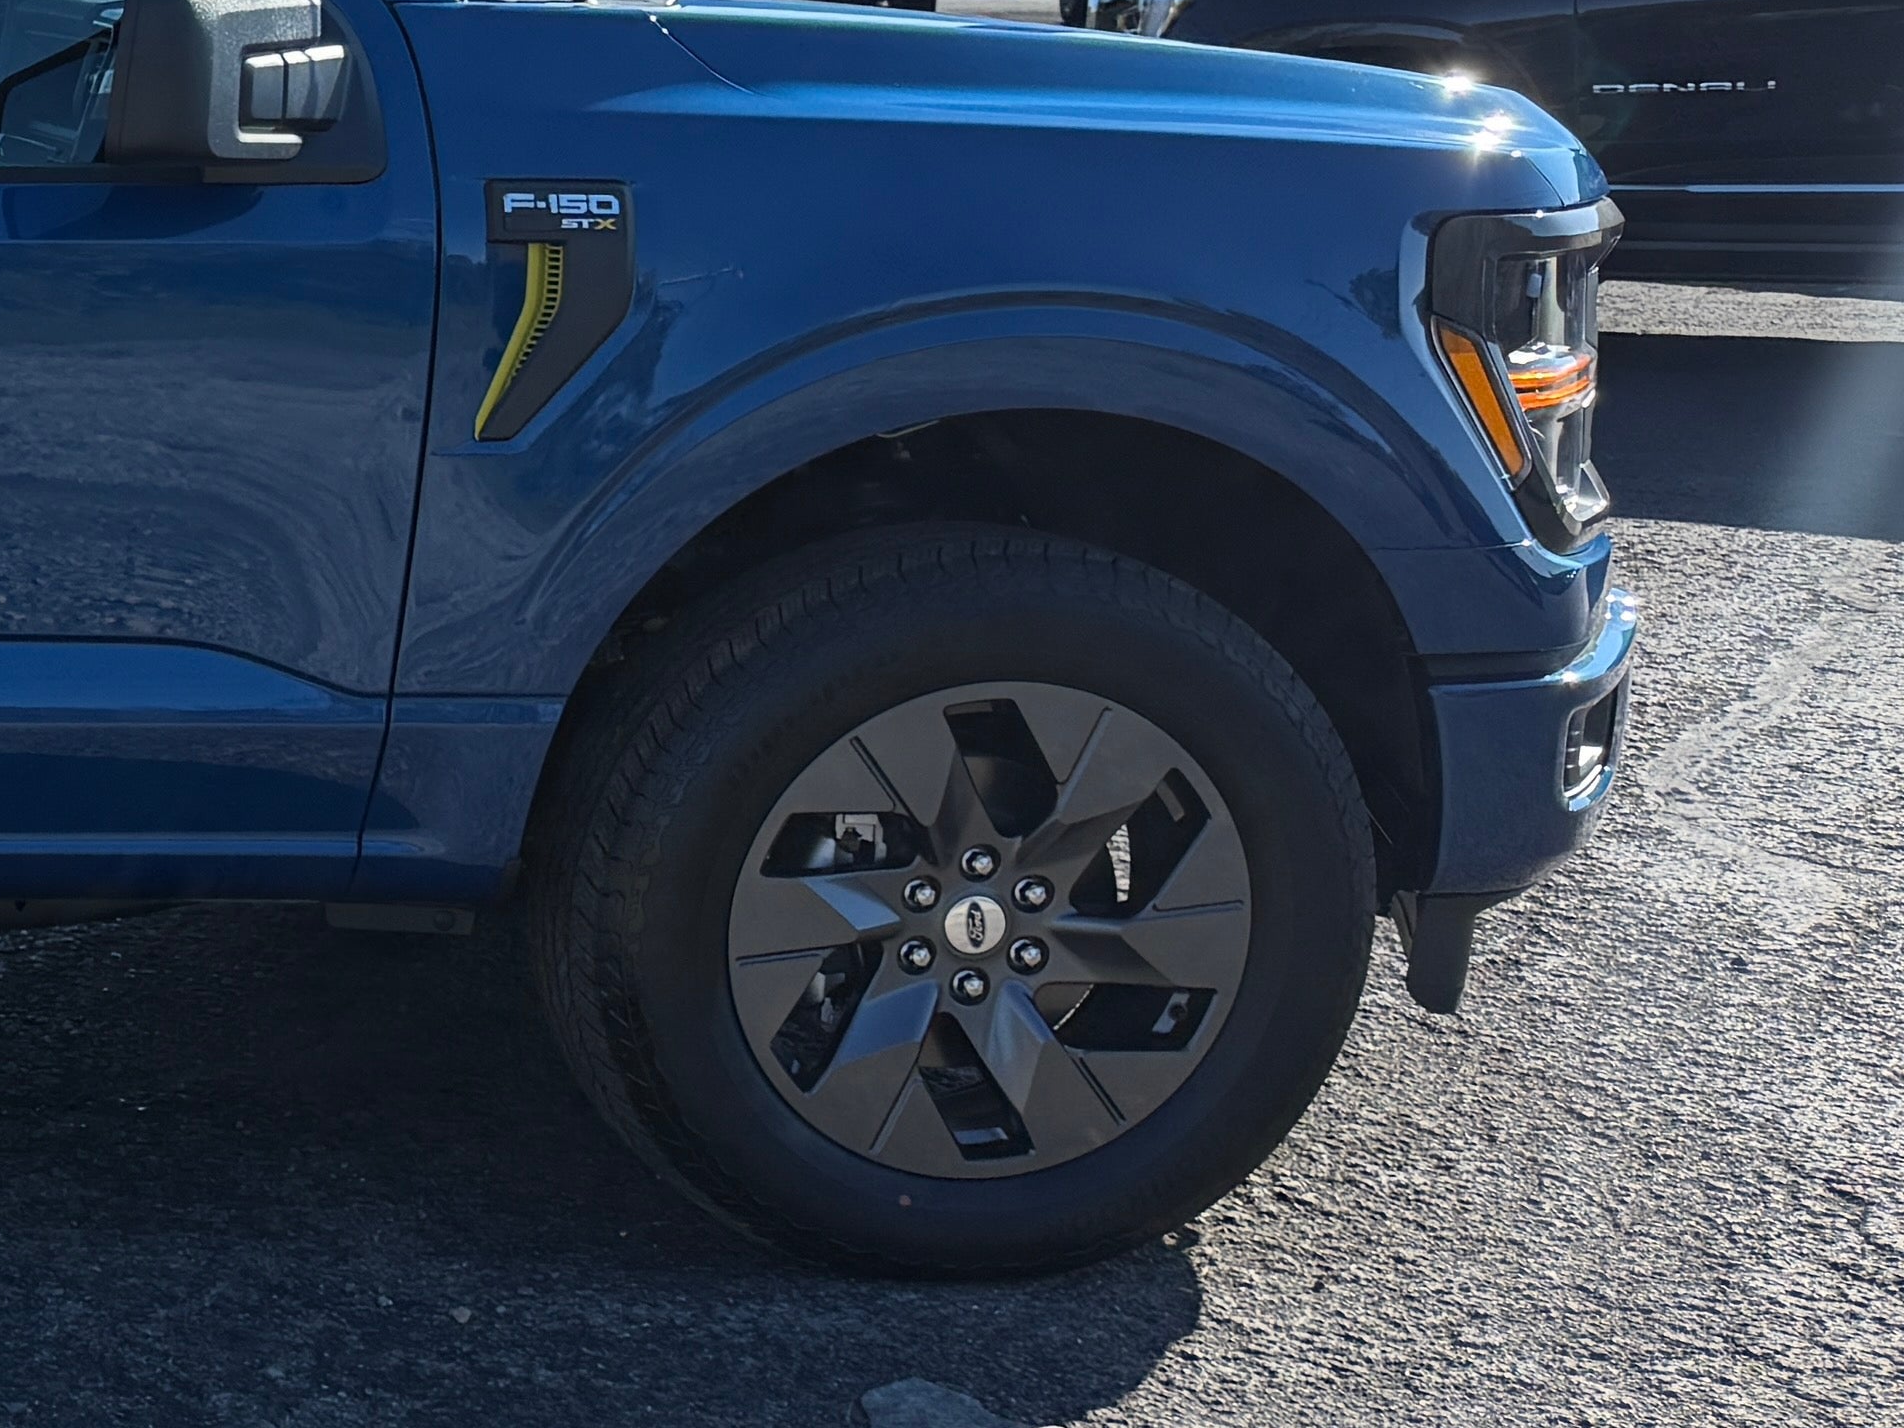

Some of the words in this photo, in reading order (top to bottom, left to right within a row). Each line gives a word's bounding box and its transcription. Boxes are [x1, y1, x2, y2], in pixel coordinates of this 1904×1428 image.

[1592, 80, 1777, 94] DENALI
[503, 193, 620, 215] F-150
[560, 218, 617, 230] STX
